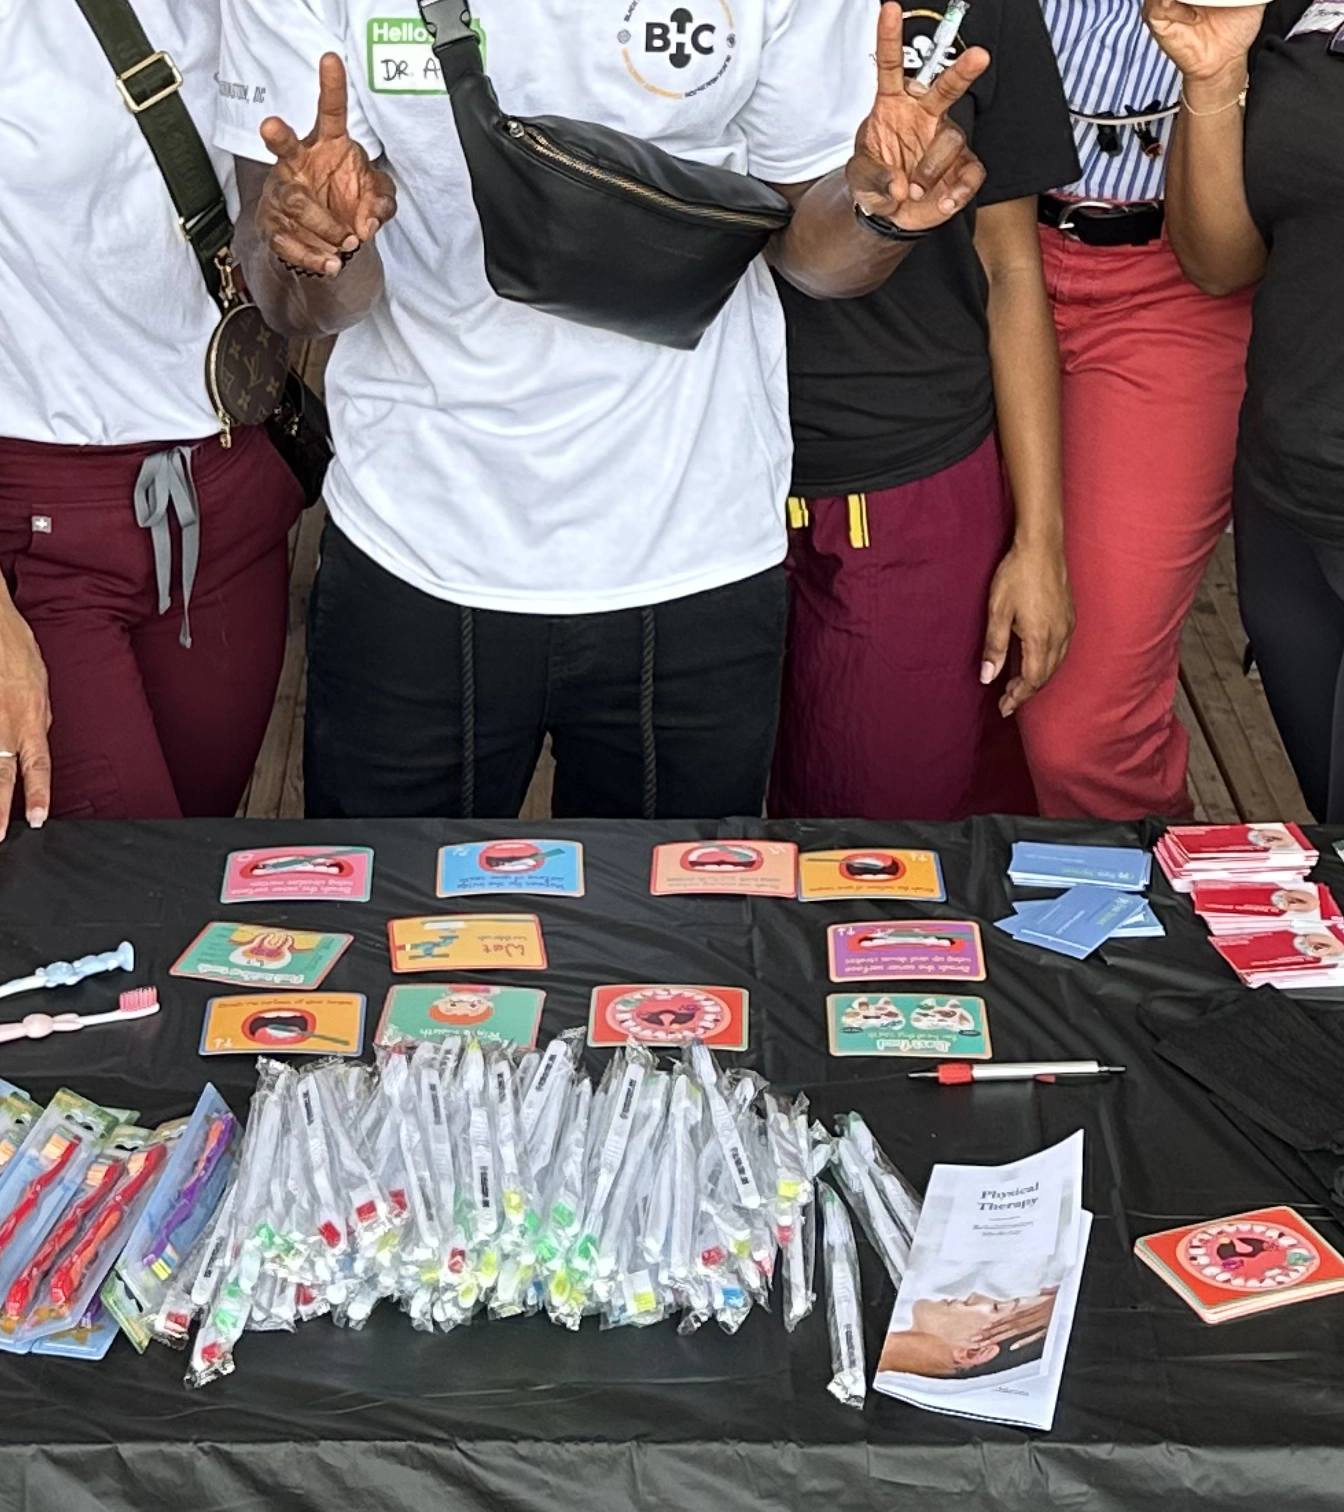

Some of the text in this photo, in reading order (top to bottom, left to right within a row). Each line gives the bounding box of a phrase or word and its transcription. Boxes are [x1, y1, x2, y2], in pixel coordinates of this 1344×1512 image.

[482, 944, 525, 957] Wet
[980, 1181, 1040, 1201] Physical
[976, 1197, 1040, 1212] Therapy
